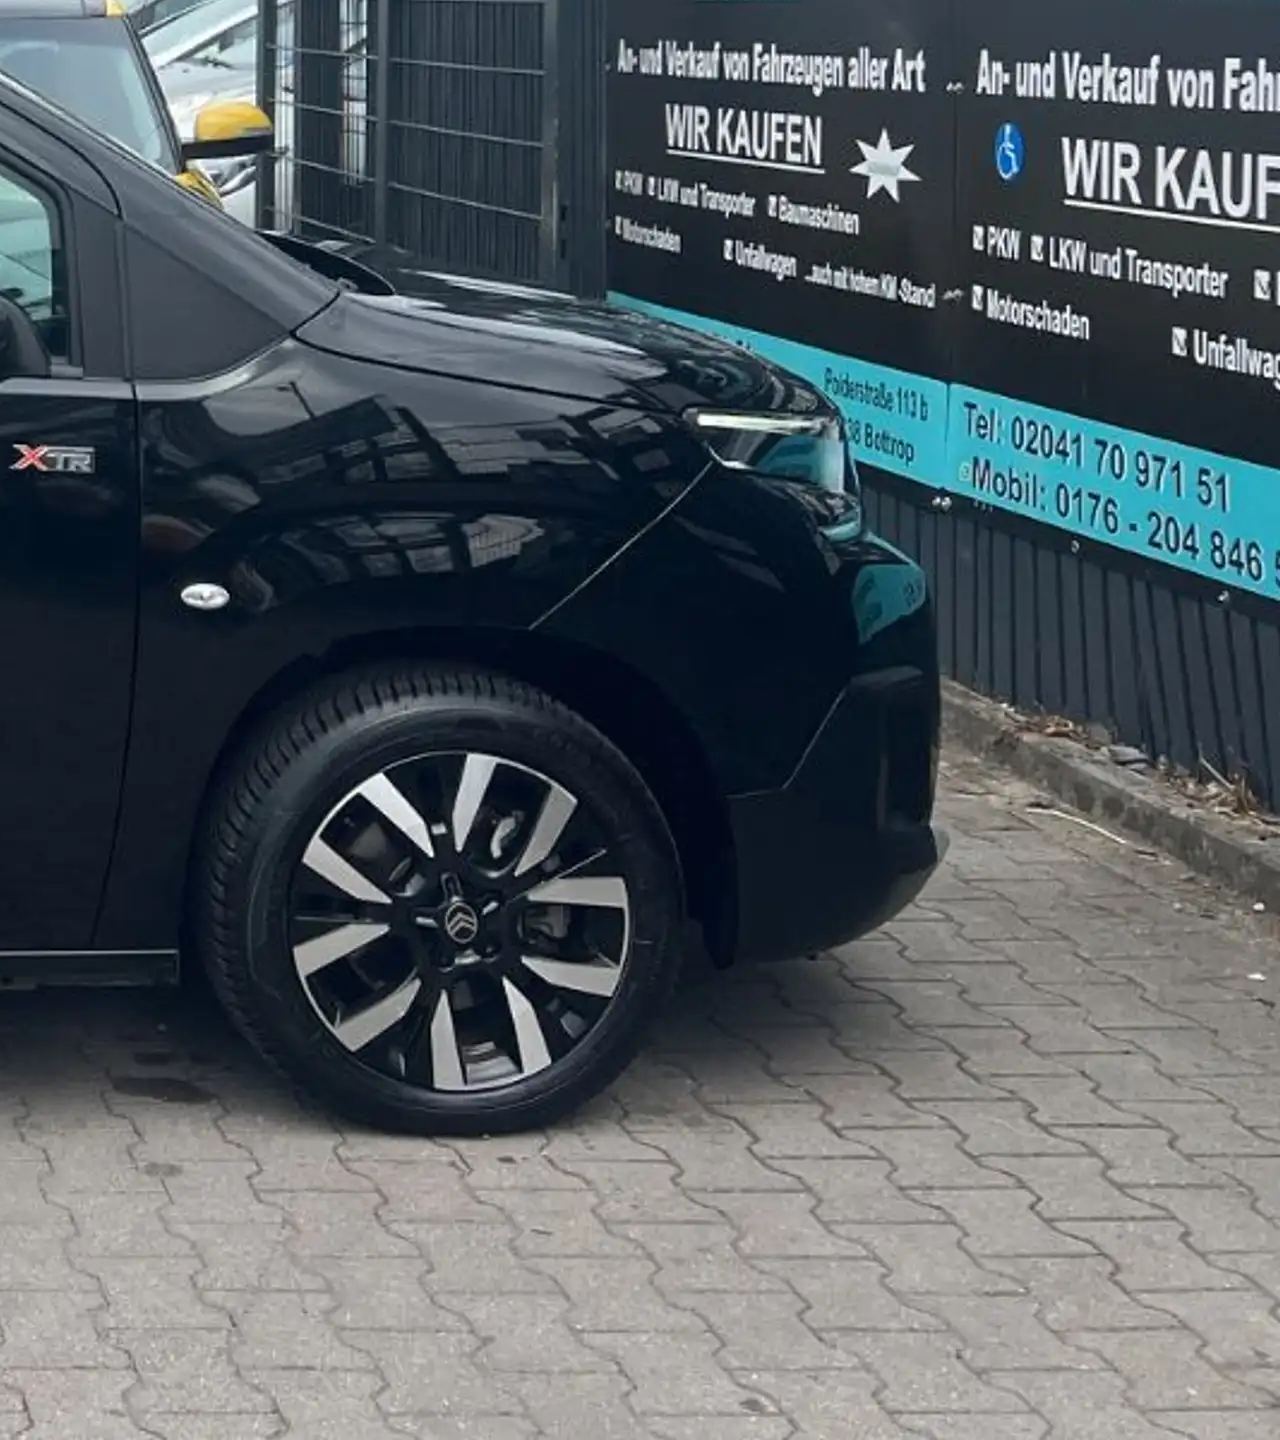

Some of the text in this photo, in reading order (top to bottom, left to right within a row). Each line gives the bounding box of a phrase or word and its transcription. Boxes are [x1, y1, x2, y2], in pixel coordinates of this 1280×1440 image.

[616, 38, 926, 97] An- und Verkauf von Fahrzeugen aller Art
[976, 48, 1011, 96] An-
[1016, 50, 1057, 100] und
[1062, 51, 1162, 106] Verkauf
[1166, 68, 1215, 110] von
[664, 103, 822, 166] WIR KAUFEN
[680, 181, 698, 208] und
[700, 182, 757, 220] Transporter
[1061, 136, 1280, 220] WIR KAUF
[622, 217, 682, 254] Motorschaden
[778, 194, 859, 236] Baumaschinen
[735, 239, 797, 281] Unfallwagen
[987, 226, 1230, 299] PKW LKW und Transporter
[987, 287, 1090, 340] Motorschaden
[897, 387, 917, 419] 113
[919, 390, 929, 421] b
[9, 444, 94, 473] XTR
[865, 423, 915, 467] Bottrop
[964, 401, 1232, 513] Tel: 02041 70 971 51
[971, 455, 1048, 513] Mobil:
[1056, 483, 1121, 536] 0176
[1147, 511, 1200, 559] 204
[1210, 530, 1264, 582] 846
